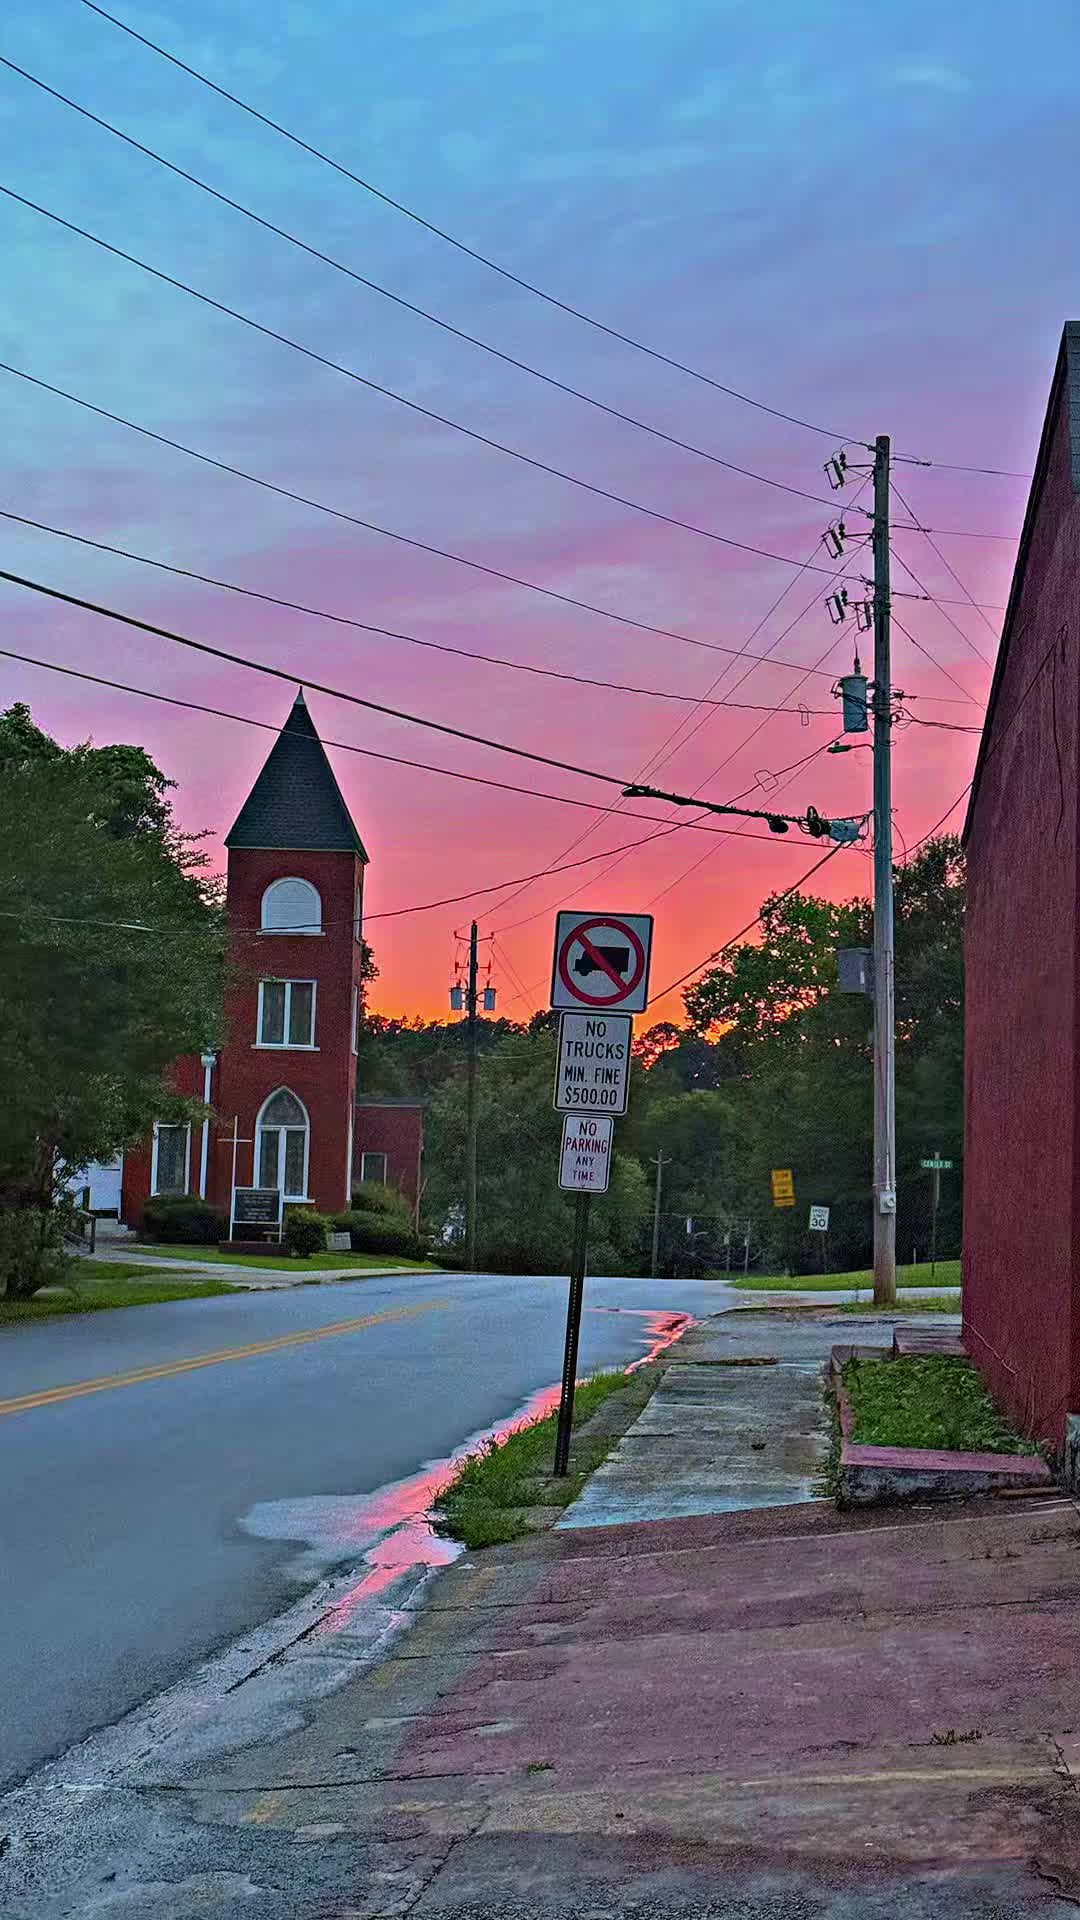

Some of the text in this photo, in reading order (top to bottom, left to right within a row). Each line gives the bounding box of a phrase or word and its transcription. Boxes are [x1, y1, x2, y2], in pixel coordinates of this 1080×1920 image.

[586, 1020, 607, 1037] NO
[565, 1040, 625, 1060] TRUCKS
[564, 1065, 620, 1085] MIN. FINE
[564, 1085, 618, 1106] $500.00
[579, 1121, 597, 1136] NO
[565, 1136, 608, 1154] PARKING
[575, 1156, 595, 1166] ANY
[573, 1170, 595, 1181] TIME
[811, 1217, 826, 1228] 30
